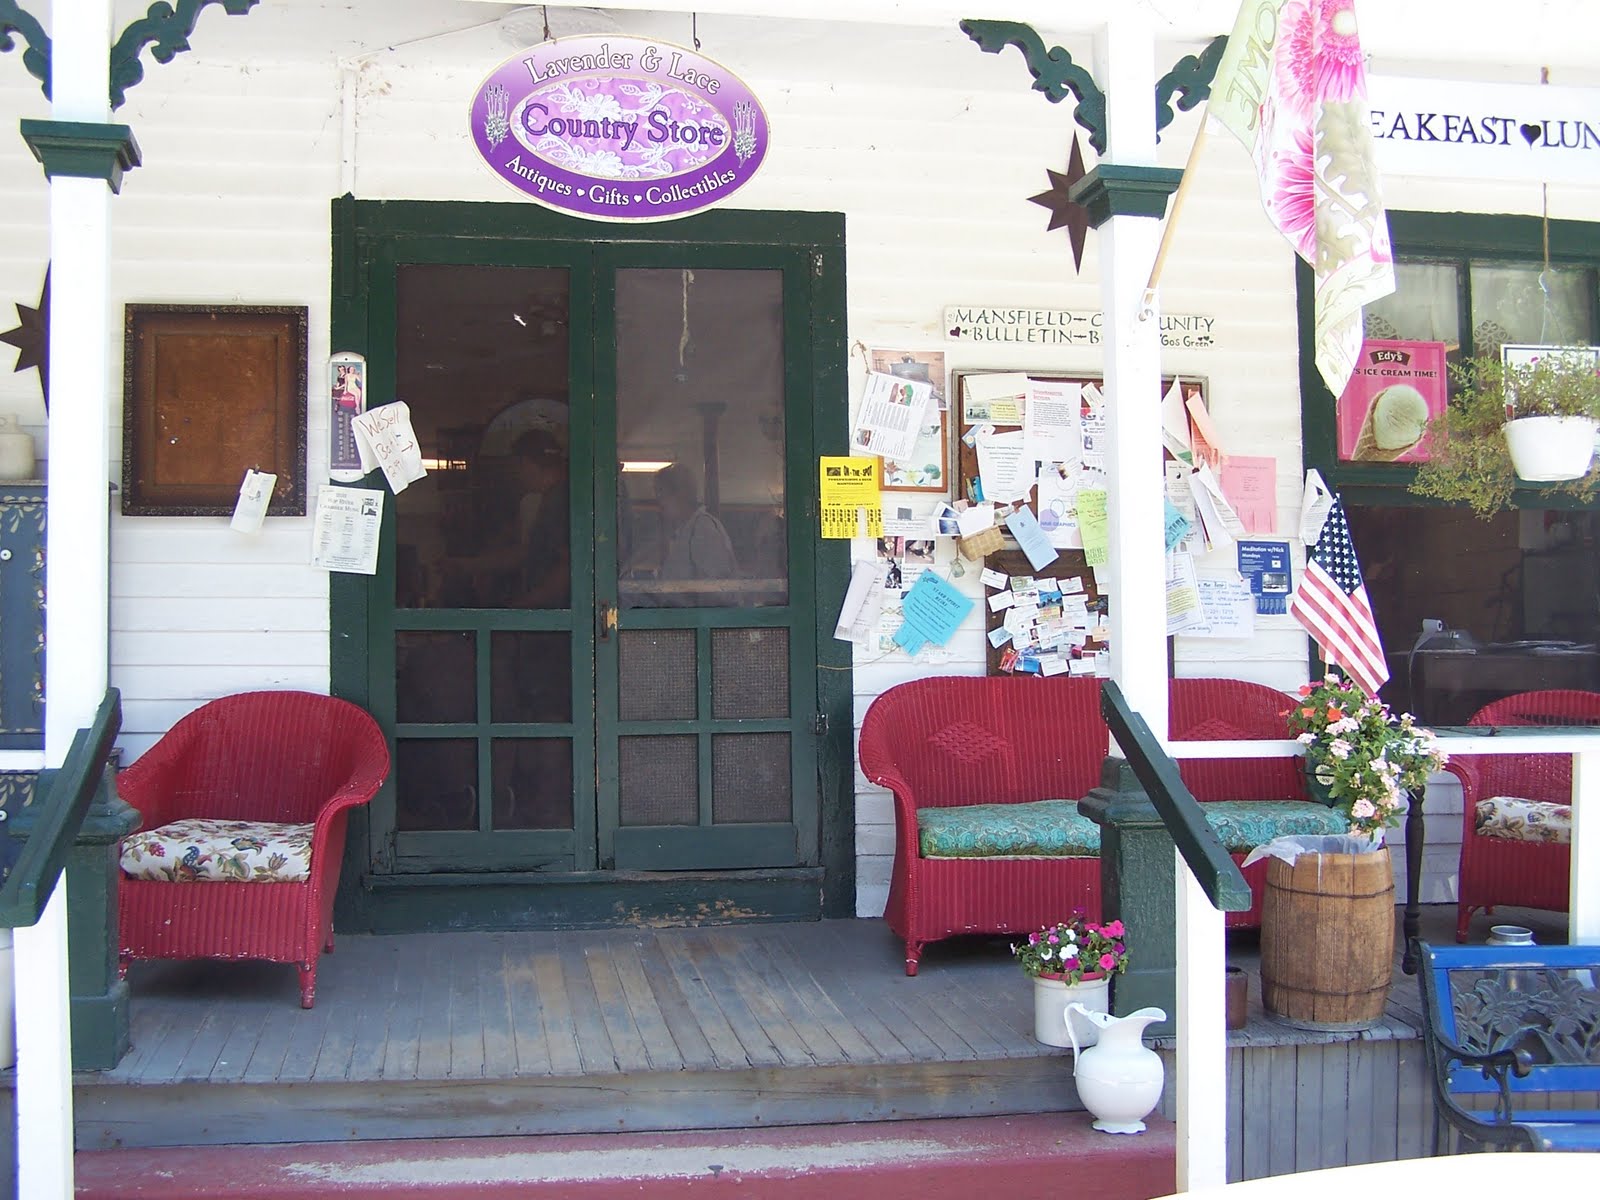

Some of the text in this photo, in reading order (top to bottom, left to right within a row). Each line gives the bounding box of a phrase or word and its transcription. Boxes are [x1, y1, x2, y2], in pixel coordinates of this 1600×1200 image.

[524, 44, 721, 95] Lavender & Lace
[521, 104, 724, 150] Country Store
[1370, 110, 1600, 149] EAKFAST LUN
[504, 155, 736, 206] Antiques Gifts Collectibles
[1363, 368, 1378, 376] ICE
[1380, 369, 1411, 377] CREAM
[1414, 370, 1438, 378] TIME!
[1377, 351, 1403, 362] Edy's
